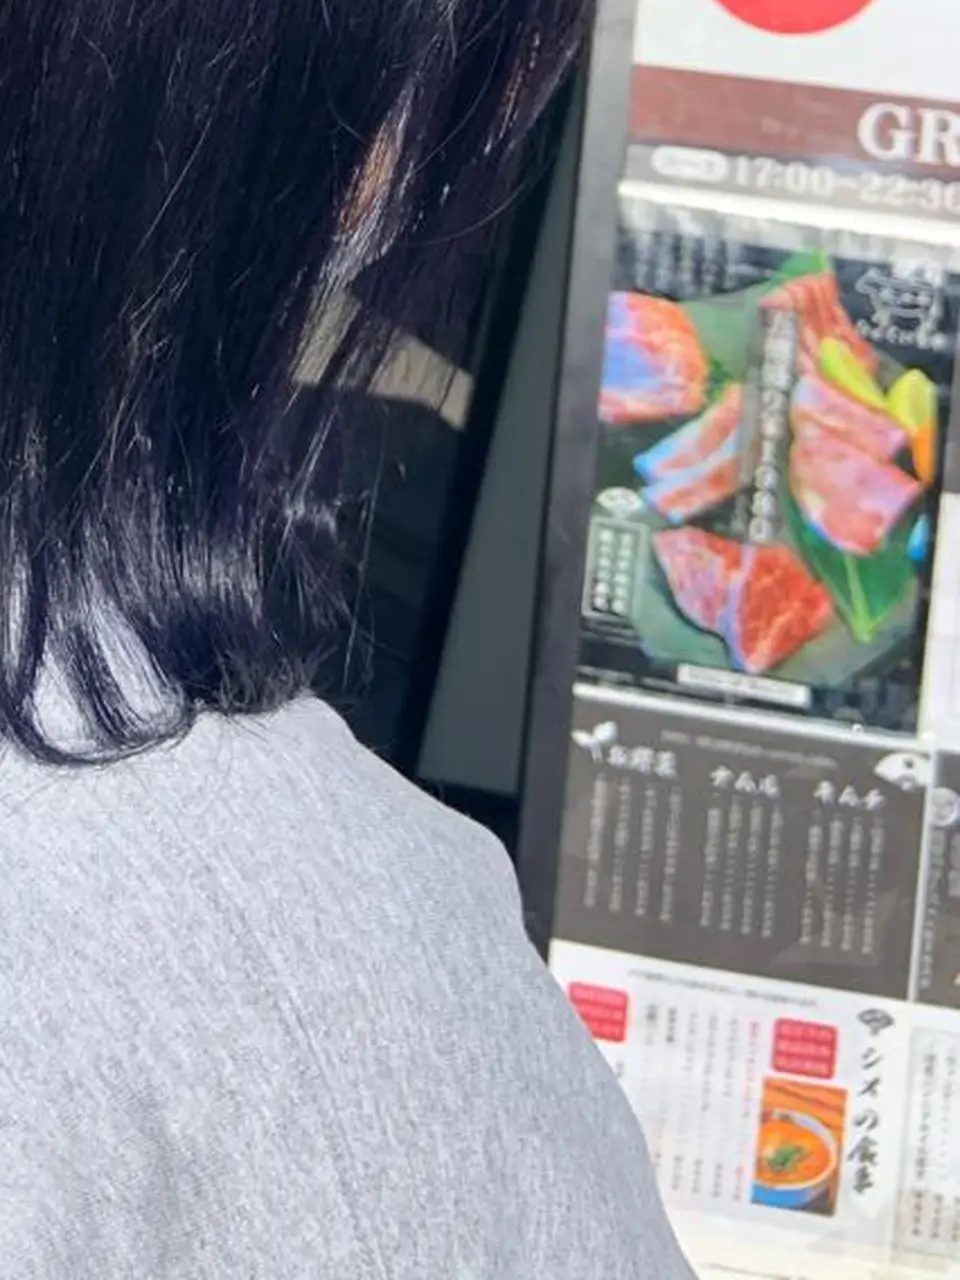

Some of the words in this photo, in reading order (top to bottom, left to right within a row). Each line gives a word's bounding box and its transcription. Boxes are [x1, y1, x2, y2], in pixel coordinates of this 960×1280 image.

[857, 102, 960, 167] GR
[846, 1047, 886, 1196] シメの食事
